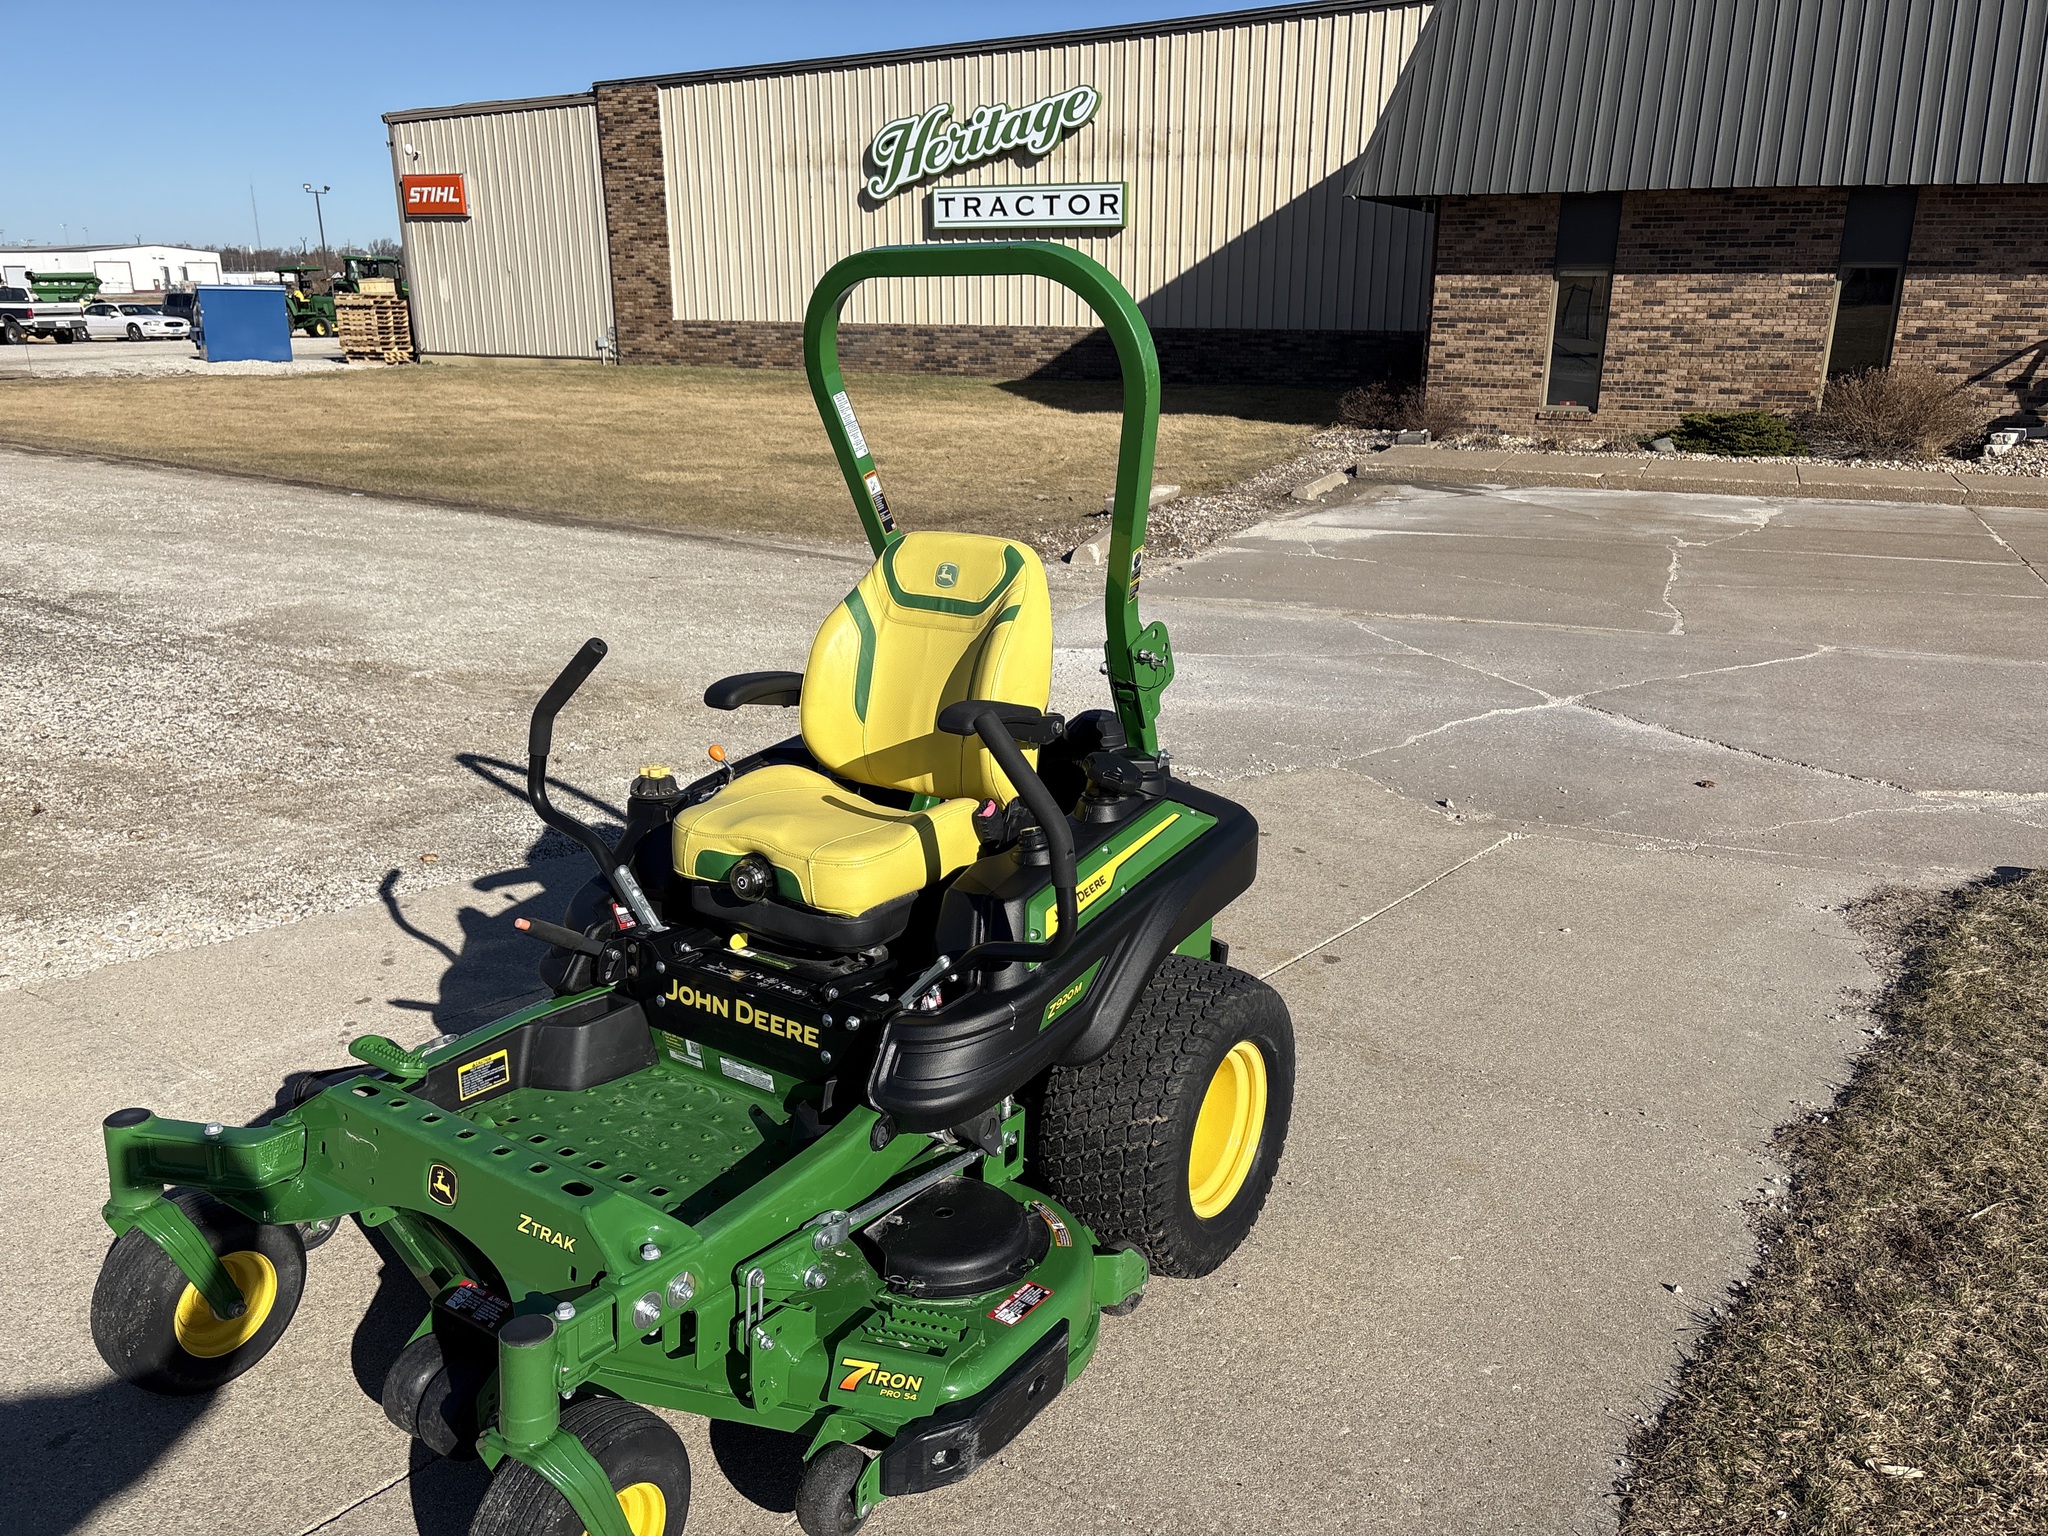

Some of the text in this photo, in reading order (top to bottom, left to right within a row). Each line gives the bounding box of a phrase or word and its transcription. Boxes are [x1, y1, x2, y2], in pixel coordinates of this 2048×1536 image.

[868, 86, 1100, 199] Heritage
[408, 186, 460, 203] STIHL
[938, 193, 1119, 218] TRACTOR
[1076, 875, 1107, 903] DEERE
[665, 978, 820, 1049] JOHN DEERE
[1047, 981, 1083, 1020] Z920M
[517, 1212, 577, 1254] ZTRAK
[879, 1388, 917, 1401] PRO 54
